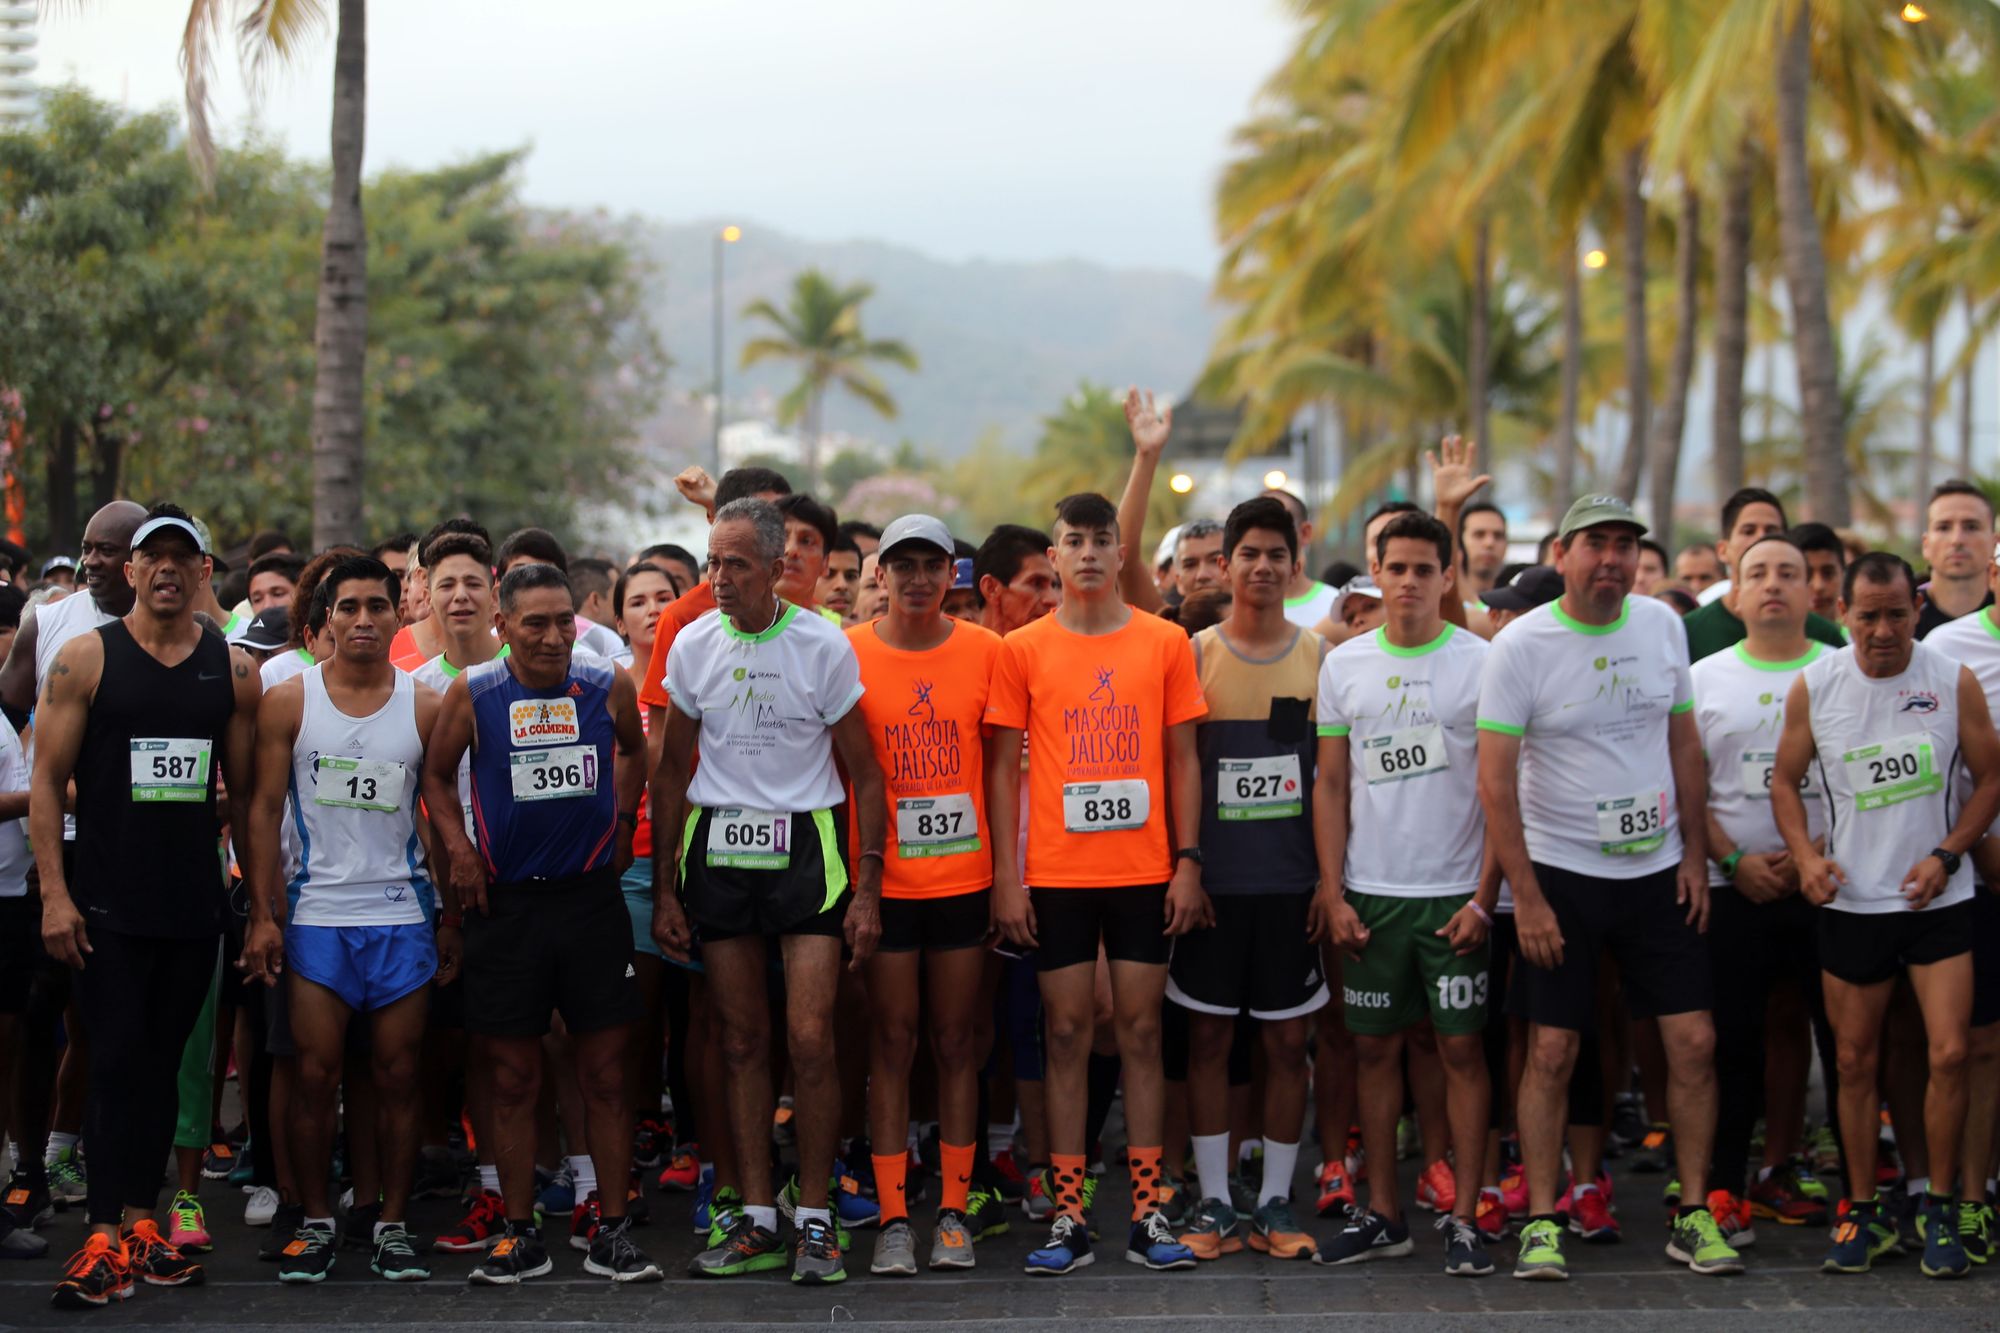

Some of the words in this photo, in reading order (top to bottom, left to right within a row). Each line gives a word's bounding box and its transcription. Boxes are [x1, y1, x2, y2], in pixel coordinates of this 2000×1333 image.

[757, 671, 781, 679] SEAPAL
[513, 727, 527, 738] LA
[529, 723, 576, 735] COLMENA
[1064, 704, 1139, 734] MASCOTA
[885, 719, 959, 750] MASCOTA
[745, 747, 761, 755] latir
[1068, 731, 1140, 765] JALISCO
[1380, 744, 1426, 773] 680
[152, 756, 197, 779] 587
[891, 744, 960, 781] JALISCO
[1868, 752, 1918, 784] 290
[346, 776, 377, 801] 13
[532, 764, 581, 790] 396
[1236, 774, 1282, 798] 627
[140, 790, 157, 799] 587
[1084, 797, 1131, 822] 838
[1620, 805, 1658, 835] 835
[725, 823, 771, 846] 605
[918, 811, 963, 836] 837
[713, 856, 729, 865] 605
[905, 847, 922, 856] 837
[1343, 985, 1391, 1008] EDECUS
[1436, 970, 1489, 1010] 103
